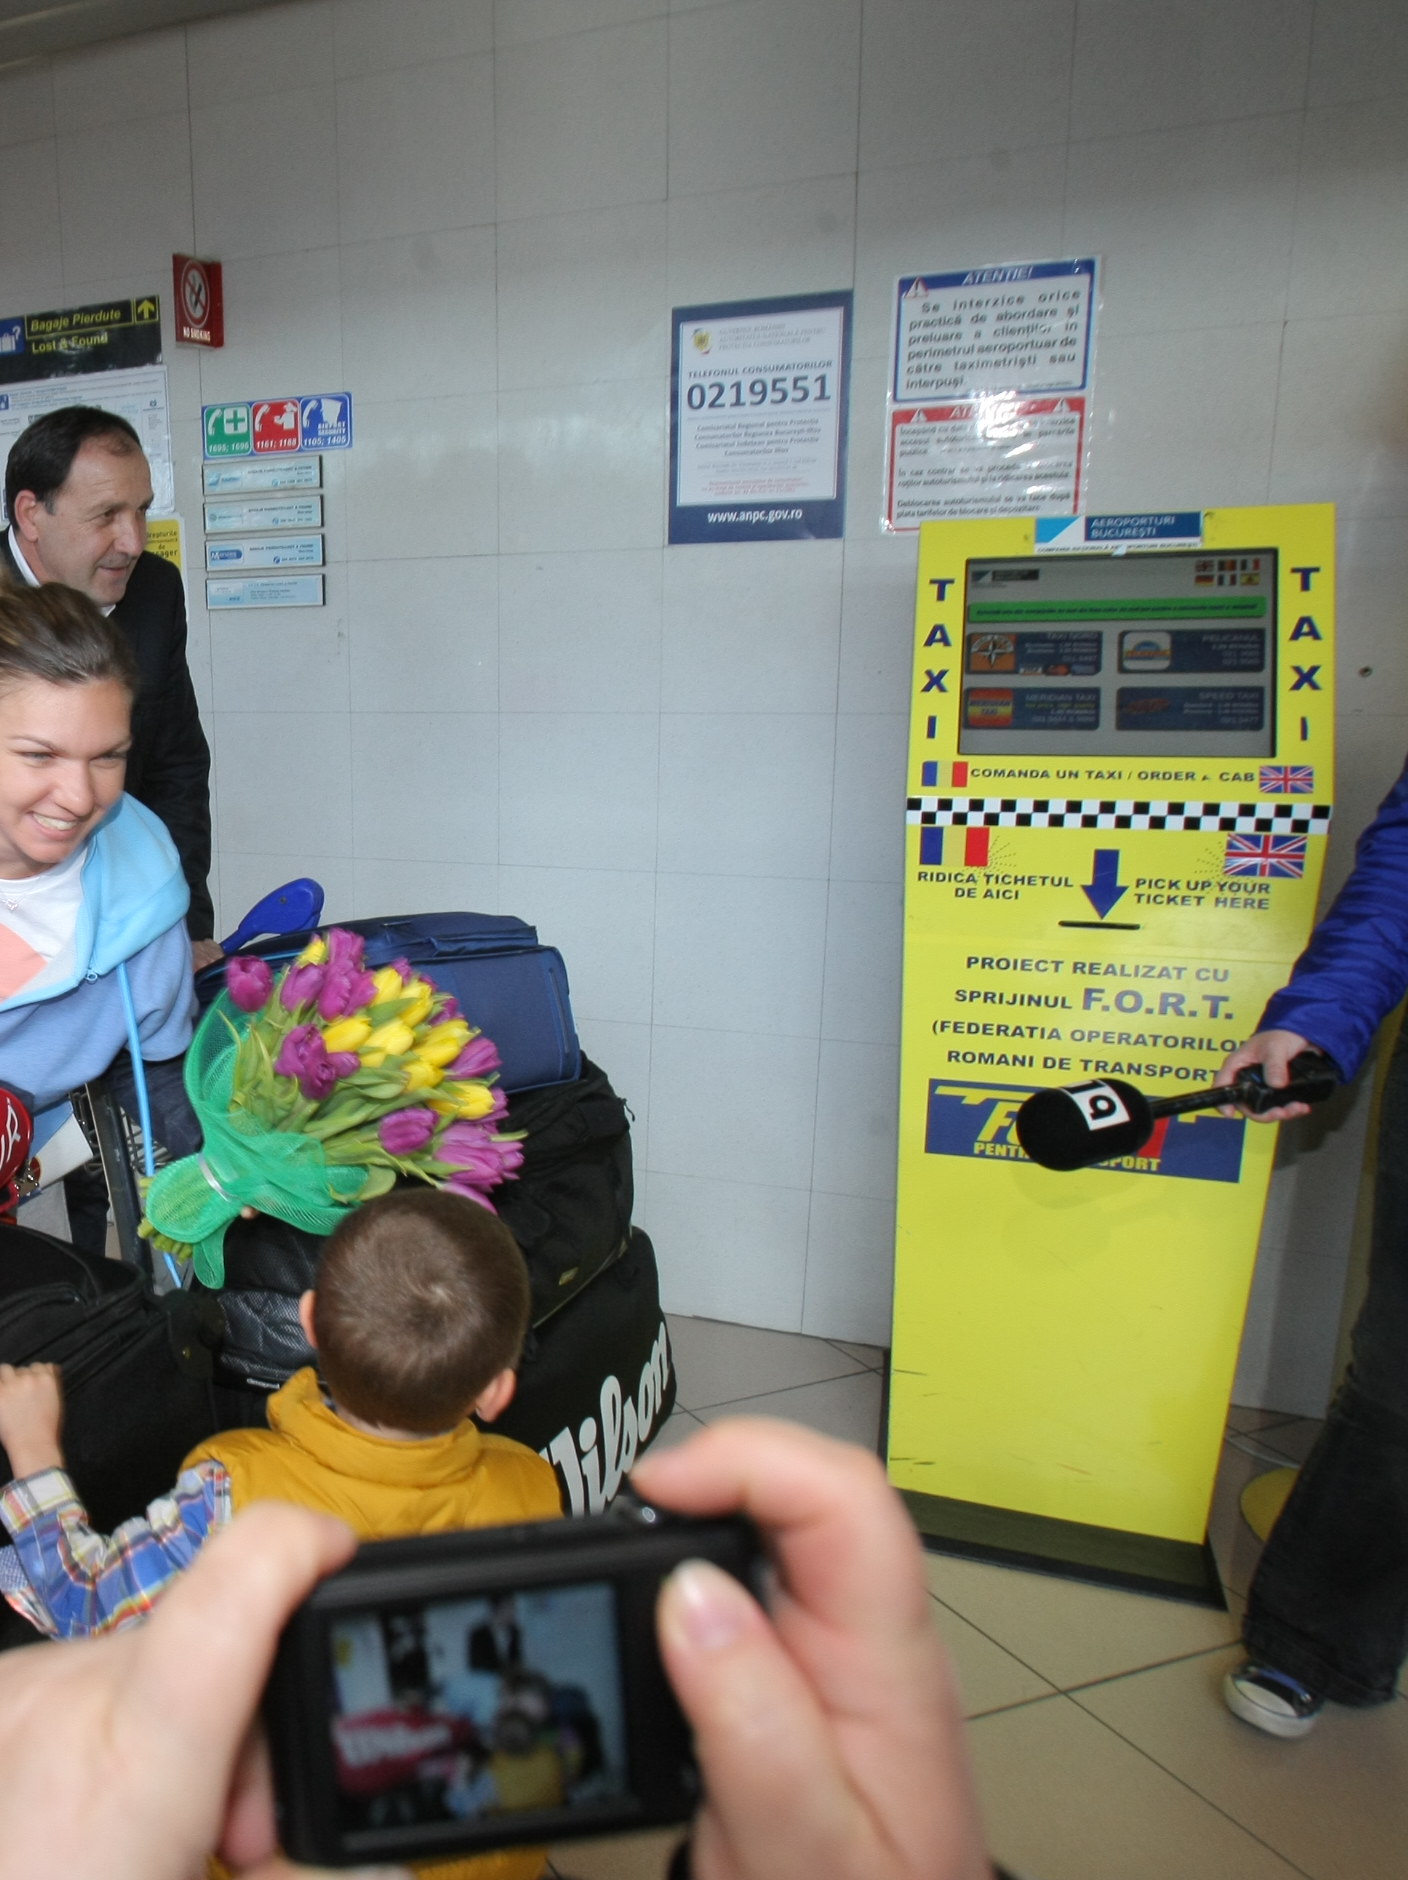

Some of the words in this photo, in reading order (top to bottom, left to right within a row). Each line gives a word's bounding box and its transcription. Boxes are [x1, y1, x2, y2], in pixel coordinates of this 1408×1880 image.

[921, 302, 940, 313] Se
[953, 295, 1026, 311] interzice
[1037, 289, 1081, 302] orice
[31, 319, 70, 332] Bagaje
[73, 310, 121, 325] Pierdute
[970, 313, 988, 324] de
[995, 307, 1058, 322] abordare
[32, 341, 56, 354] Lost
[60, 339, 69, 349] &
[72, 332, 108, 347] Found
[908, 331, 962, 347] preluare
[974, 330, 982, 338] a
[907, 344, 975, 362] perimetrul
[977, 337, 1058, 356] aeroportuar
[1060, 336, 1077, 348] de
[1048, 354, 1076, 363] sau
[688, 367, 738, 378] TELEFONUL
[742, 360, 833, 374] CONSUMATORILOR
[687, 373, 831, 410] 0219551
[766, 420, 788, 429] pentru
[766, 439, 788, 447] pentru
[708, 509, 803, 524] www.anpc.gov.ro
[1092, 516, 1175, 527] AEROPORTURI
[921, 578, 954, 739] TAXI
[1289, 566, 1322, 741] TAXI
[971, 768, 1050, 779] COMANDA
[1056, 769, 1078, 779] UN
[1086, 770, 1121, 780] TAXI
[1128, 771, 1133, 780] /
[1137, 771, 1196, 781] ORDER
[1219, 772, 1255, 782] CAB
[917, 871, 977, 884] RIDICA
[984, 874, 1074, 888] TICHETUL
[1135, 878, 1179, 890] PICK
[1185, 880, 1211, 892] UP
[1216, 881, 1271, 894] YOUR
[954, 887, 977, 898] DE
[982, 888, 1019, 900] AICI
[1134, 893, 1204, 907] TICKET
[1215, 896, 1269, 910] HERE
[966, 956, 1063, 974] PROIECT
[1072, 961, 1188, 980] REALIZAT
[1195, 967, 1230, 982] CU
[955, 989, 1072, 1010] SPRIJINUL
[1082, 987, 1234, 1020] F.O.R.T.
[932, 1019, 1062, 1041] (FEDERATIA
[947, 1050, 1034, 1068] ROMANI
[1042, 1056, 1071, 1071] DE
